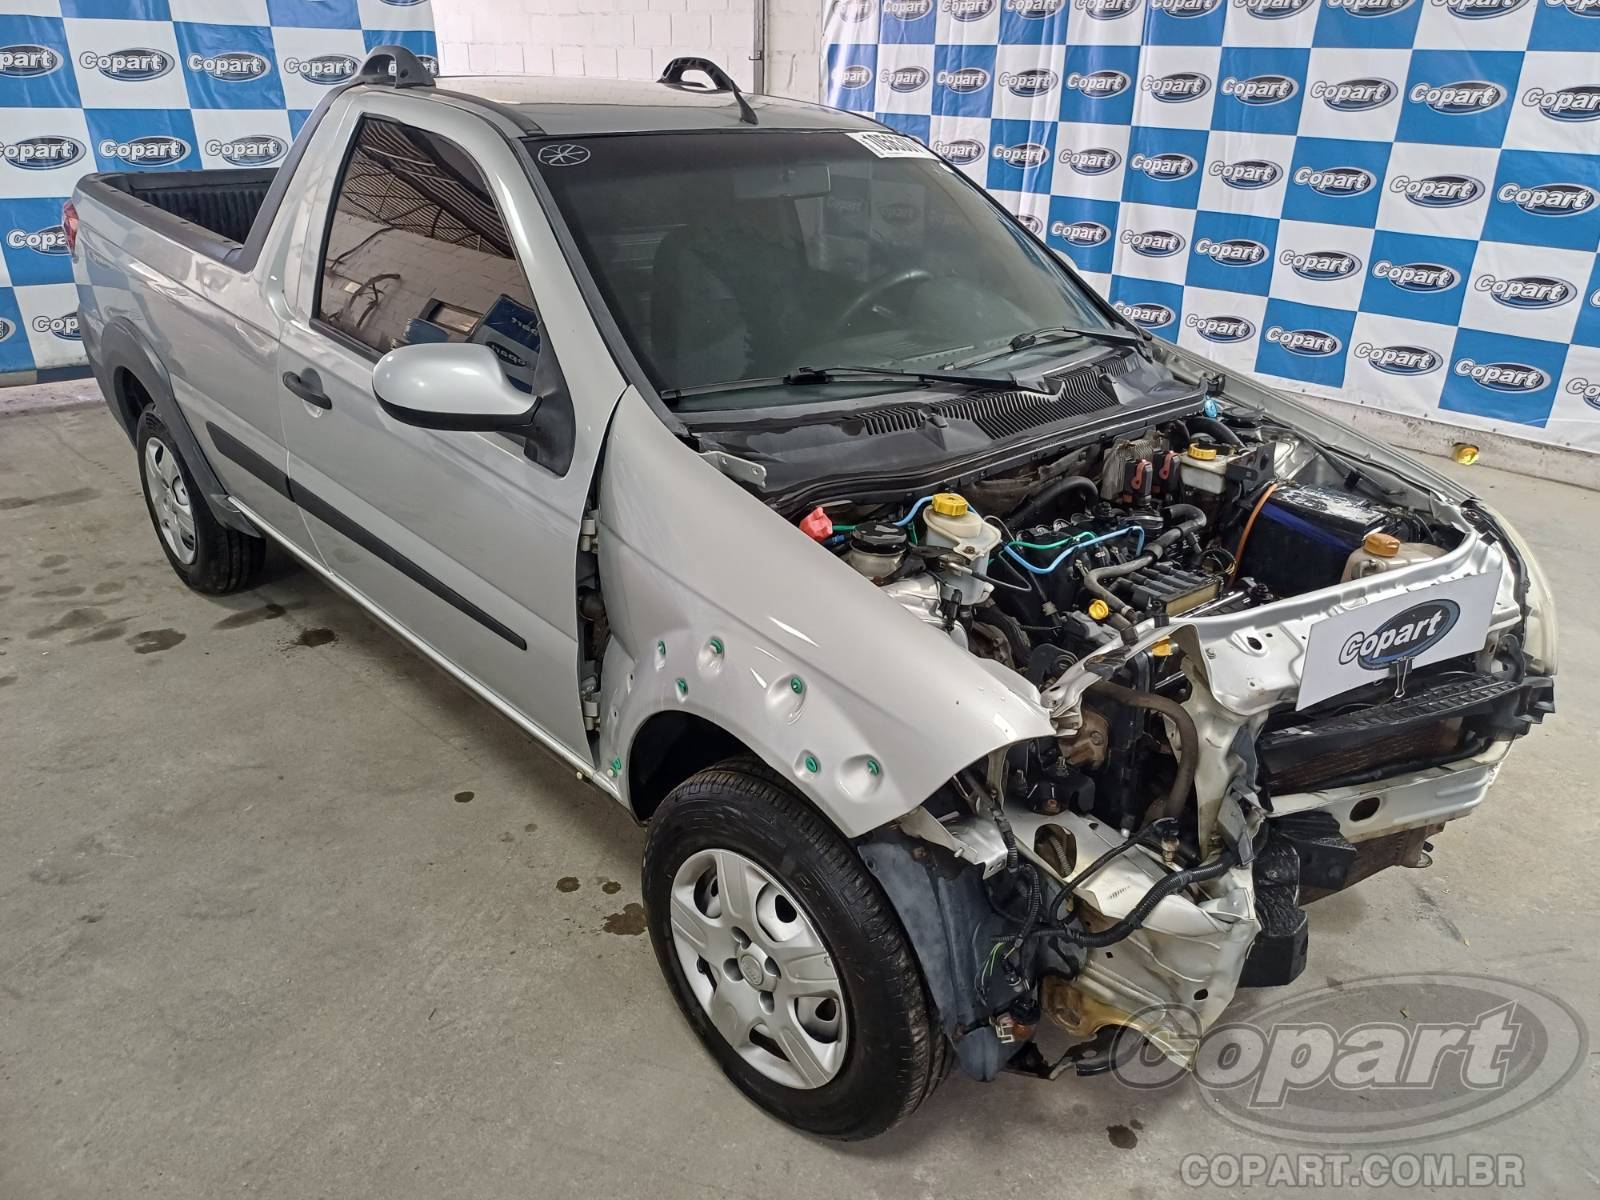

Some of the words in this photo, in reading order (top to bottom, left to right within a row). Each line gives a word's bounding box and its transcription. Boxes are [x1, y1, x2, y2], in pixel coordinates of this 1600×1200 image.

[0, 50, 52, 73] part
[79, 51, 163, 73] Copart
[188, 53, 262, 75] Copart
[284, 57, 354, 78] Copart
[880, 68, 922, 86] Copart
[937, 71, 984, 88] Copart
[999, 71, 1051, 90] Copart
[1067, 72, 1122, 92] Copart
[1141, 75, 1202, 94] Copart
[1221, 77, 1289, 100] Copart
[1311, 81, 1387, 103] Copart
[1409, 82, 1497, 107] Copart
[1522, 87, 1600, 113] Copar
[0, 137, 74, 163] opart
[100, 139, 180, 161] Copart
[206, 139, 279, 158] Copart
[933, 140, 978, 158] Copart
[992, 144, 1044, 164] Copart
[1059, 149, 1113, 168] Copart
[1131, 154, 1189, 174] Copart
[1209, 160, 1274, 182] Copart
[1294, 166, 1369, 190] Copart
[1390, 175, 1476, 199] Copart
[1498, 183, 1592, 209] Copart
[7, 229, 66, 251] Copa
[1051, 221, 1105, 241] Copart
[1120, 229, 1179, 252] Copart
[1196, 238, 1262, 261] Copart
[1279, 250, 1353, 273] Copart
[1372, 260, 1452, 287] Copart
[1475, 275, 1566, 301] Copart
[1113, 301, 1169, 324] Copart
[32, 315, 79, 335] Cop
[1186, 314, 1249, 337] Copart
[1265, 326, 1337, 354] Copart
[1354, 342, 1435, 369] Copart
[1454, 358, 1543, 389] Copart
[1338, 609, 1443, 665] Copart
